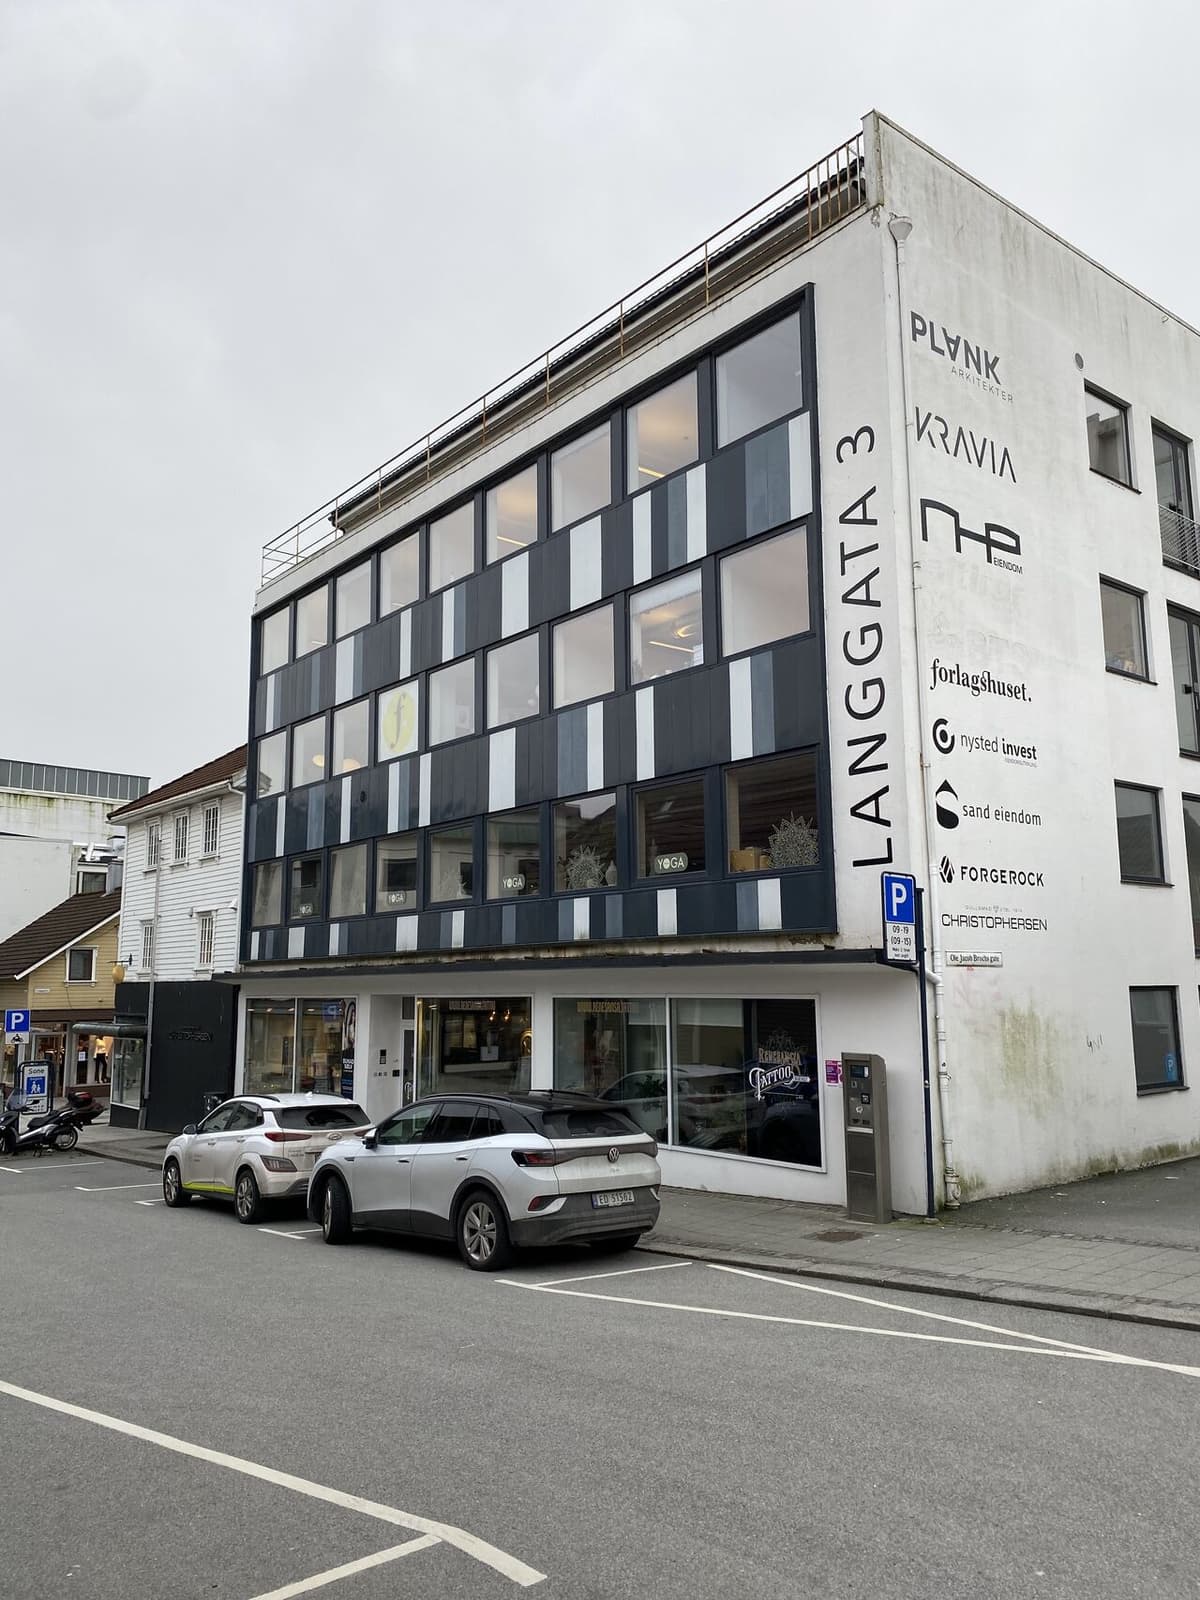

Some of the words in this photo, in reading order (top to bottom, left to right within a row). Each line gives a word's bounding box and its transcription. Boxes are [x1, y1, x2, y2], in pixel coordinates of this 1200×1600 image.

[910, 310, 1001, 385] PLANK
[951, 365, 1014, 404] ARKITEKTER
[836, 425, 876, 464] 3
[915, 406, 1017, 483] KRAVIA
[993, 557, 1023, 575] EIENDOM
[839, 485, 893, 868] LANGGATA
[929, 658, 1032, 702] forlagshuset.
[960, 733, 999, 753] nysted
[1001, 738, 1038, 761] invest
[962, 804, 990, 820] sand
[994, 806, 1042, 826] eiendom
[657, 856, 685, 870] YOGA
[502, 877, 523, 889] YOGA
[960, 866, 1045, 887] FORGEROCK
[891, 882, 907, 917] P
[941, 913, 1048, 931] CHRISTOPHERSEN
[11, 1012, 24, 1030] P
[28, 1067, 45, 1075] Sone
